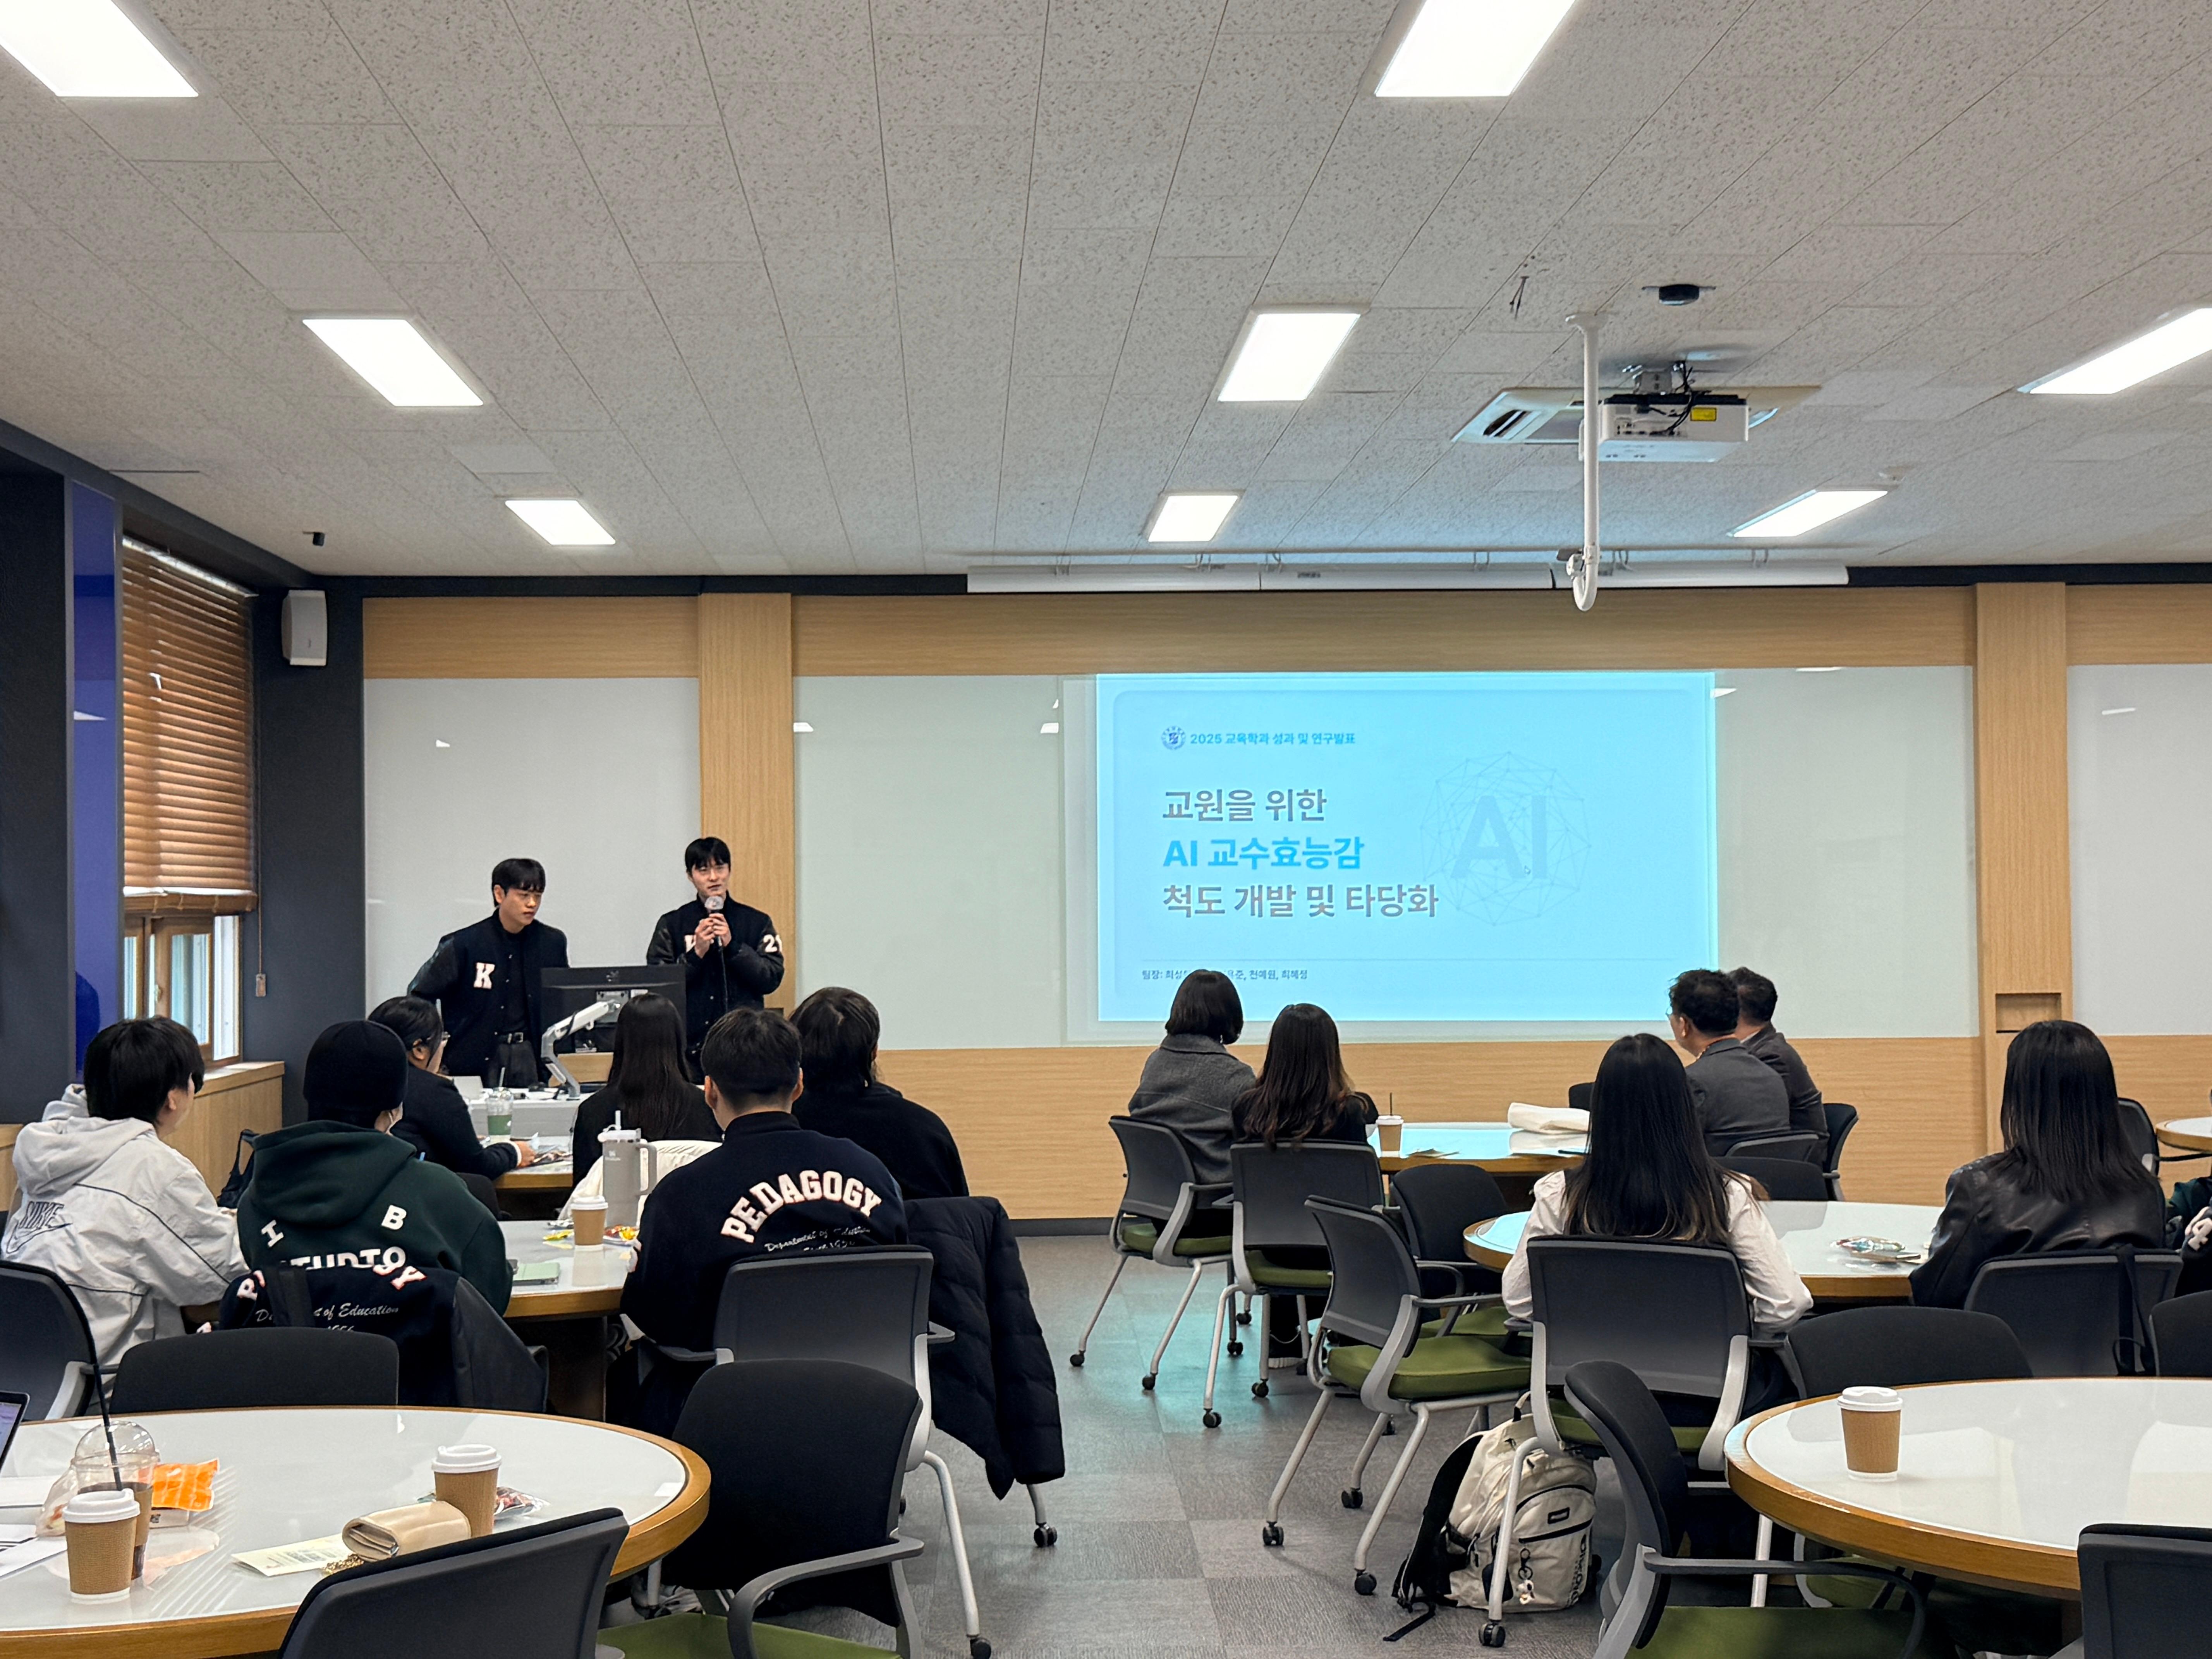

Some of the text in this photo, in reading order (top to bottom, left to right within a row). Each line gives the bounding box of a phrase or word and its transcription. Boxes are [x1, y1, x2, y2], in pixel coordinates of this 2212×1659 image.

[1190, 733, 1222, 744] 2025
[1224, 733, 1269, 745] 교육학과
[1273, 733, 1295, 745] 성과
[1298, 733, 1309, 745] 및
[1312, 733, 1355, 745] 연구발표
[1163, 789, 1327, 822] 교원을 위한
[1450, 795, 1548, 878] AI
[1163, 836, 1365, 870] AI 교수효능감
[1163, 884, 1439, 918] 척도 개발 및 타당화
[474, 962, 495, 989] K
[19, 1201, 64, 1229] NIKE
[381, 1204, 407, 1230] B
[720, 1170, 882, 1243] PEDAGOGY
[280, 1246, 406, 1269] TUDIO
[323, 1305, 335, 1317] of
[338, 1302, 399, 1318] Education
